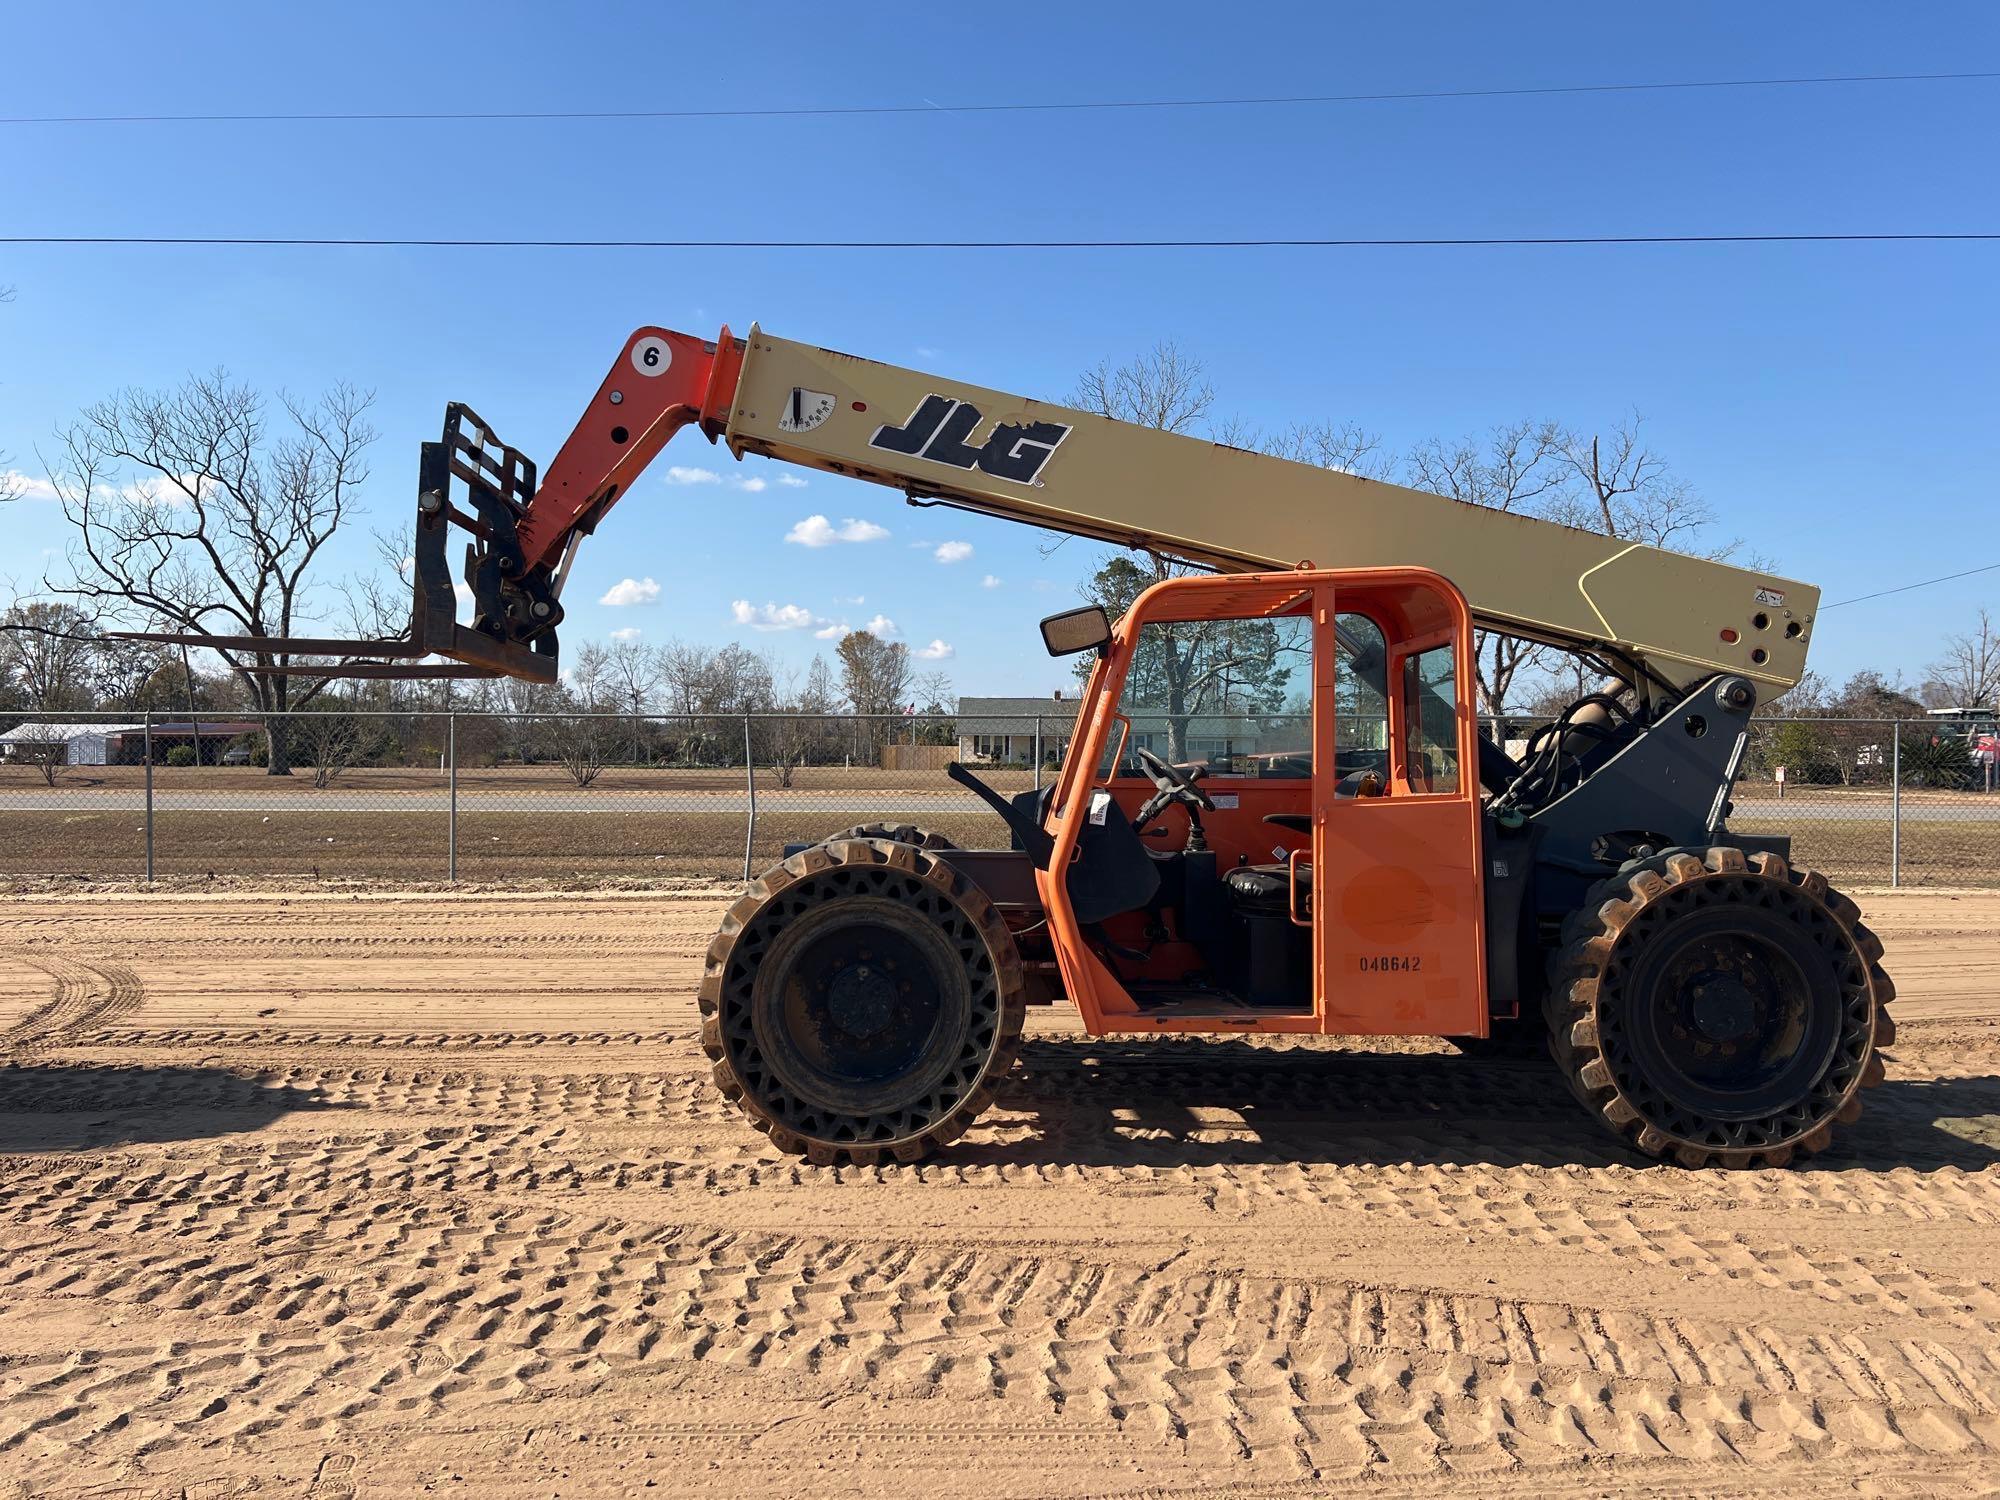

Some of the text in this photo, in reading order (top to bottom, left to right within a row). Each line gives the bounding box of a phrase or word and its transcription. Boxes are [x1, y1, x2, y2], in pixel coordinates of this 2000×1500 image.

[643, 346, 660, 367] 6
[868, 393, 1073, 485] JLG
[1359, 956, 1421, 972] 048642
